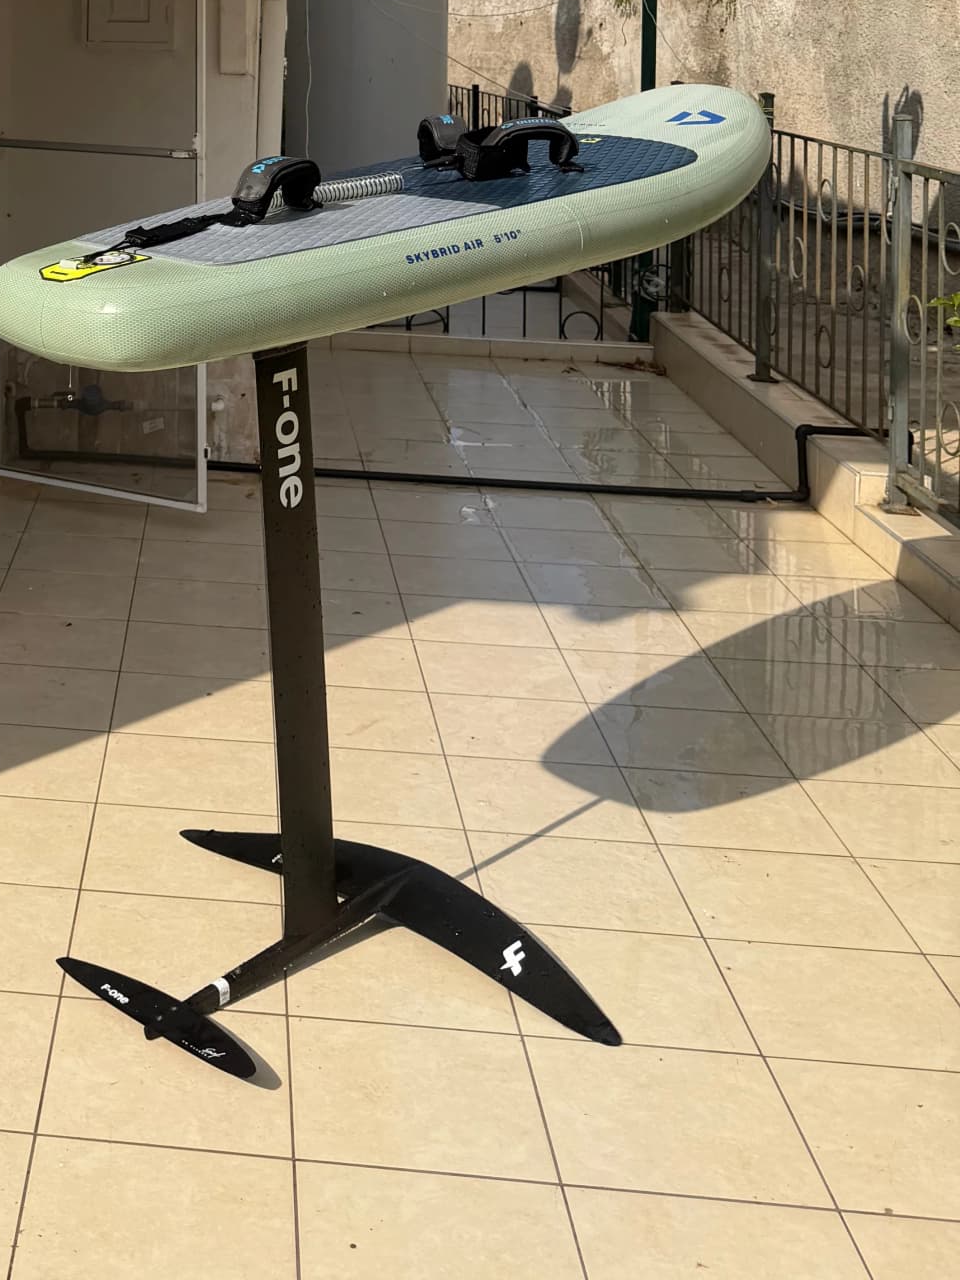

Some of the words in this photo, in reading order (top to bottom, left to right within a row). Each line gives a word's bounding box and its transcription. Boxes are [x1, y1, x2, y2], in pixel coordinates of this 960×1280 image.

[405, 243, 461, 265] SKYBRID
[463, 238, 484, 252] AIR
[272, 367, 304, 509] F-one
[100, 983, 129, 1004] F-one
